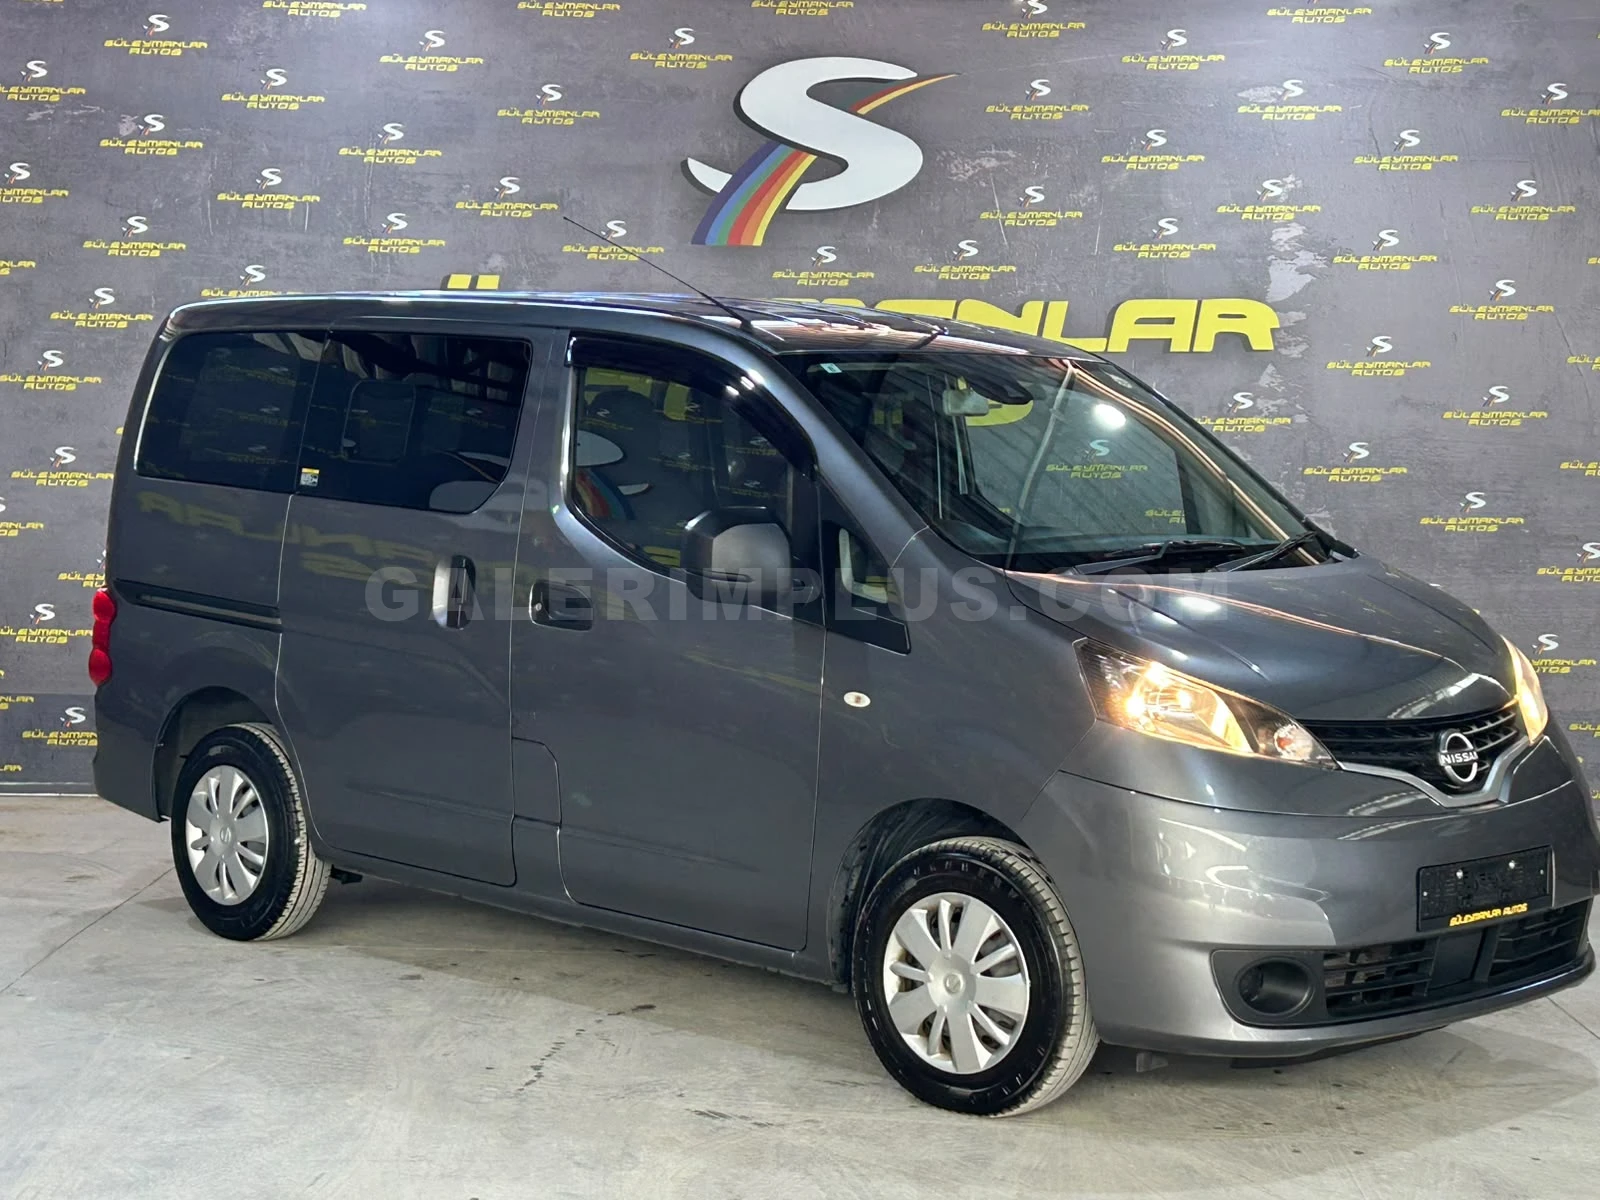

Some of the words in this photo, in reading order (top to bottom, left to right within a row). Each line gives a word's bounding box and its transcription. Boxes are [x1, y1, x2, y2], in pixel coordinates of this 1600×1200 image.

[288, 9, 342, 17] AUTOS
[542, 9, 595, 17] AUTOS
[776, 7, 829, 15] AUTOS
[1291, 15, 1347, 23] AUTOS
[1007, 30, 1061, 38] AUTOS
[129, 48, 183, 56] AUTOS
[404, 63, 458, 71] AUTOS
[655, 60, 708, 68] AUTOS
[1146, 62, 1200, 70] AUTOS
[1408, 65, 1463, 73] AUTOS
[0, 85, 86, 94] LEYMANLAR
[7, 94, 60, 102] AUTOS
[245, 101, 300, 109] AUTOS
[1010, 111, 1063, 119] AUTOS
[1263, 112, 1317, 120] AUTOS
[522, 116, 575, 124] AUTOS
[1525, 116, 1580, 124] AUTOS
[124, 148, 179, 156] AUTOS
[363, 156, 417, 164] AUTOS
[1126, 162, 1179, 170] AUTOS
[1378, 162, 1433, 170] AUTOS
[0, 188, 69, 197] YMANLAR
[0, 196, 43, 204] UTOS
[241, 201, 294, 209] AUTOS
[480, 209, 533, 217] AUTOS
[1241, 212, 1296, 220] AUTOS
[1495, 213, 1551, 221] AUTOS
[1004, 218, 1058, 226] AUTOS
[108, 249, 162, 257] AUTOS
[367, 245, 421, 253] AUTOS
[587, 253, 639, 261] AUTOS
[1138, 250, 1191, 258] AUTOS
[1357, 262, 1412, 270] AUTOS
[938, 271, 990, 279] AUTOS
[797, 277, 849, 285] AUTOS
[1474, 312, 1529, 320] AUTOS
[74, 320, 128, 328] AUTOS
[1351, 368, 1405, 376] AUTOS
[22, 383, 76, 391] AUTOS
[1194, 416, 1291, 425] ÜLEYMANLAR
[1467, 418, 1523, 426] AUTOS
[35, 478, 90, 486] AUTOS
[1327, 474, 1382, 482] AUTOS
[1445, 523, 1499, 531] AUTOS
[1536, 565, 1600, 575] SÜLEYM
[0, 626, 93, 636] ÜLEYMANLAR
[15, 635, 68, 644] AUTOS
[22, 729, 98, 738] SÜLEYMA
